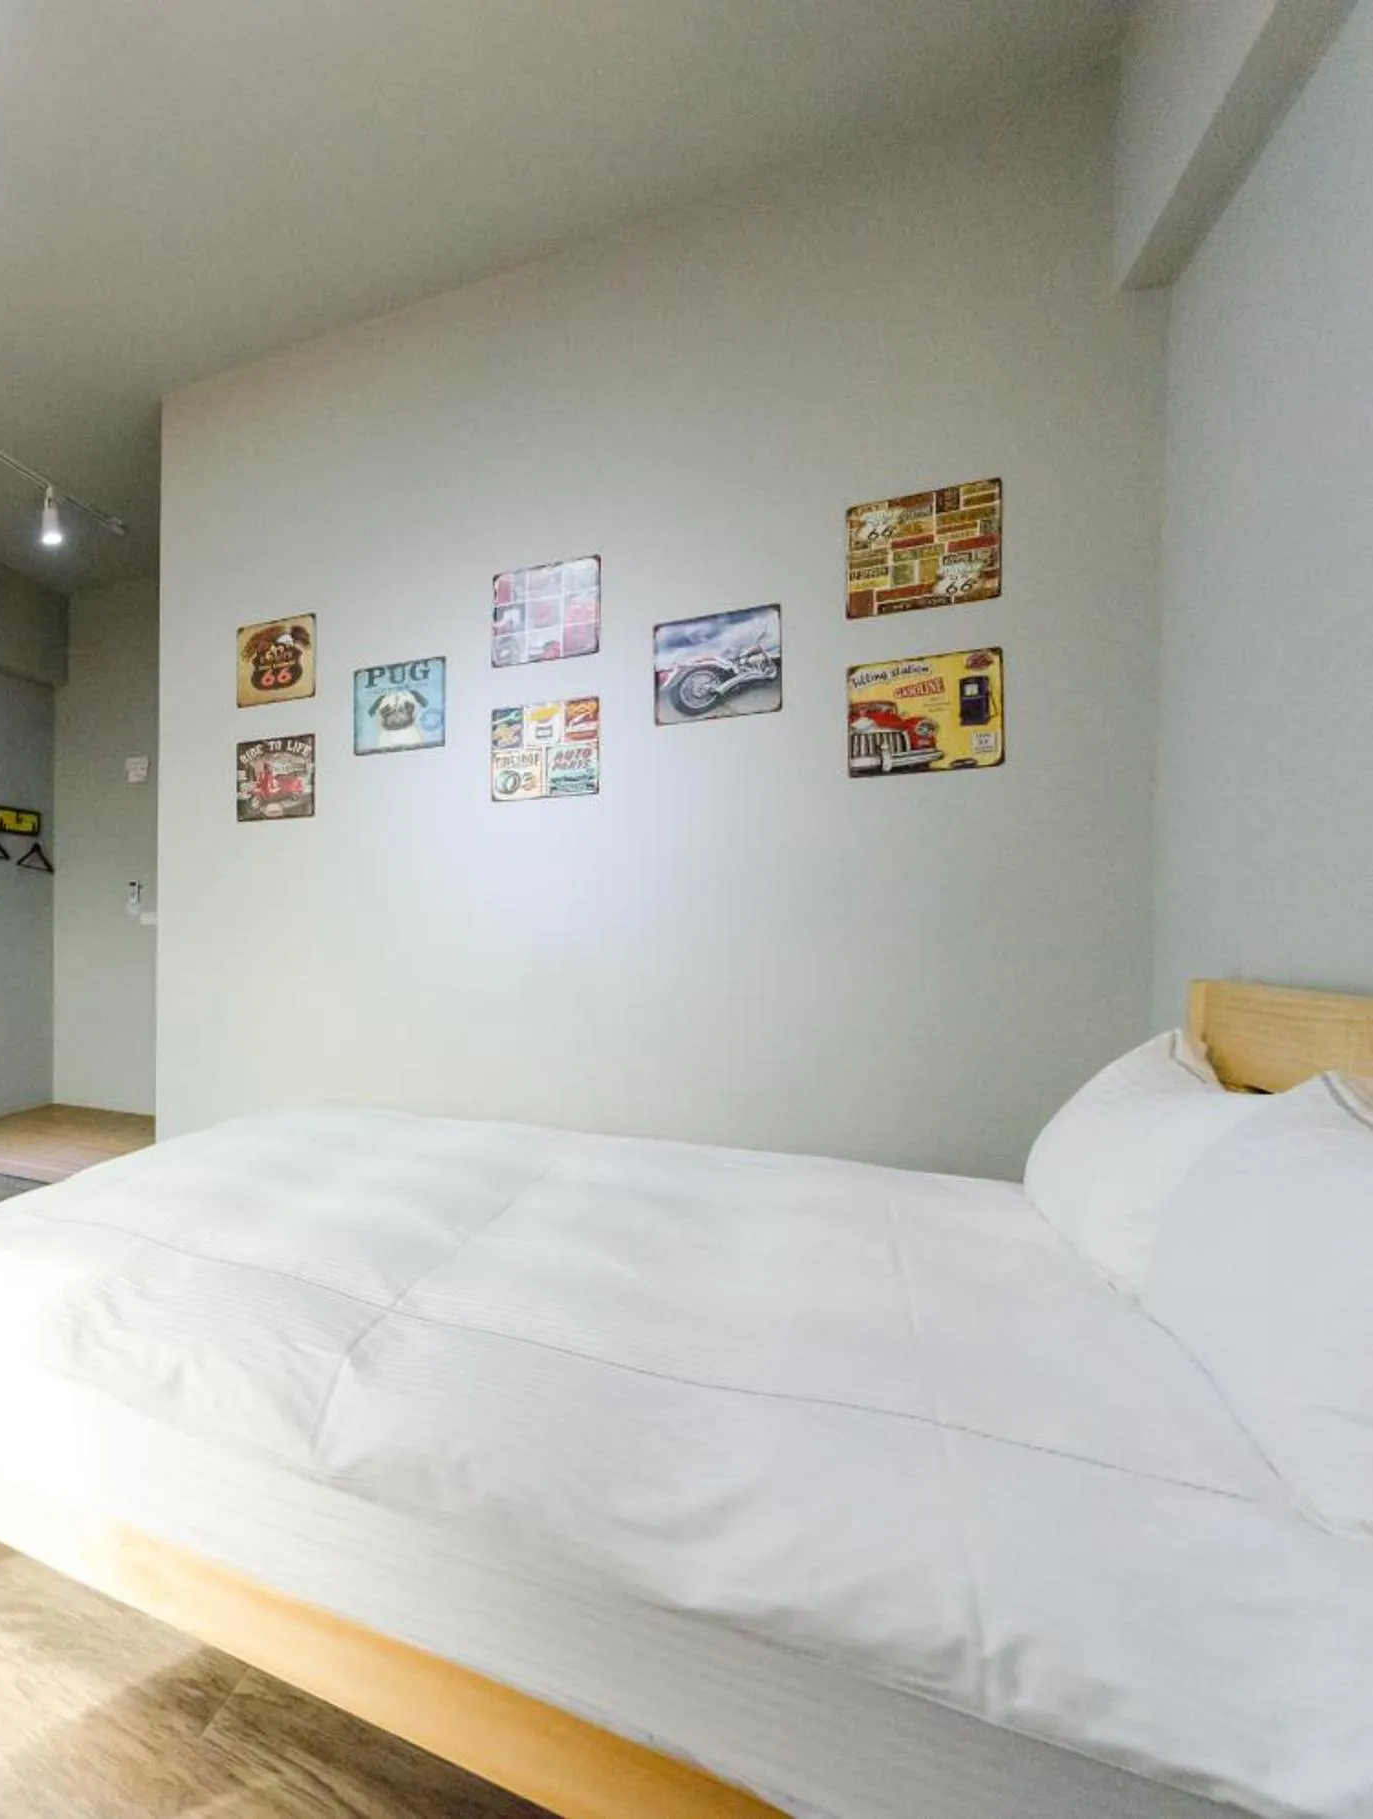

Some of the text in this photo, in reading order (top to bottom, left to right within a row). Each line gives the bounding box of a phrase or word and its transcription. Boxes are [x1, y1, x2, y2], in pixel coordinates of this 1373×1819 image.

[946, 578, 973, 595] 66
[261, 668, 293, 687] 66
[363, 660, 431, 689] PUG
[268, 741, 282, 751] TO
